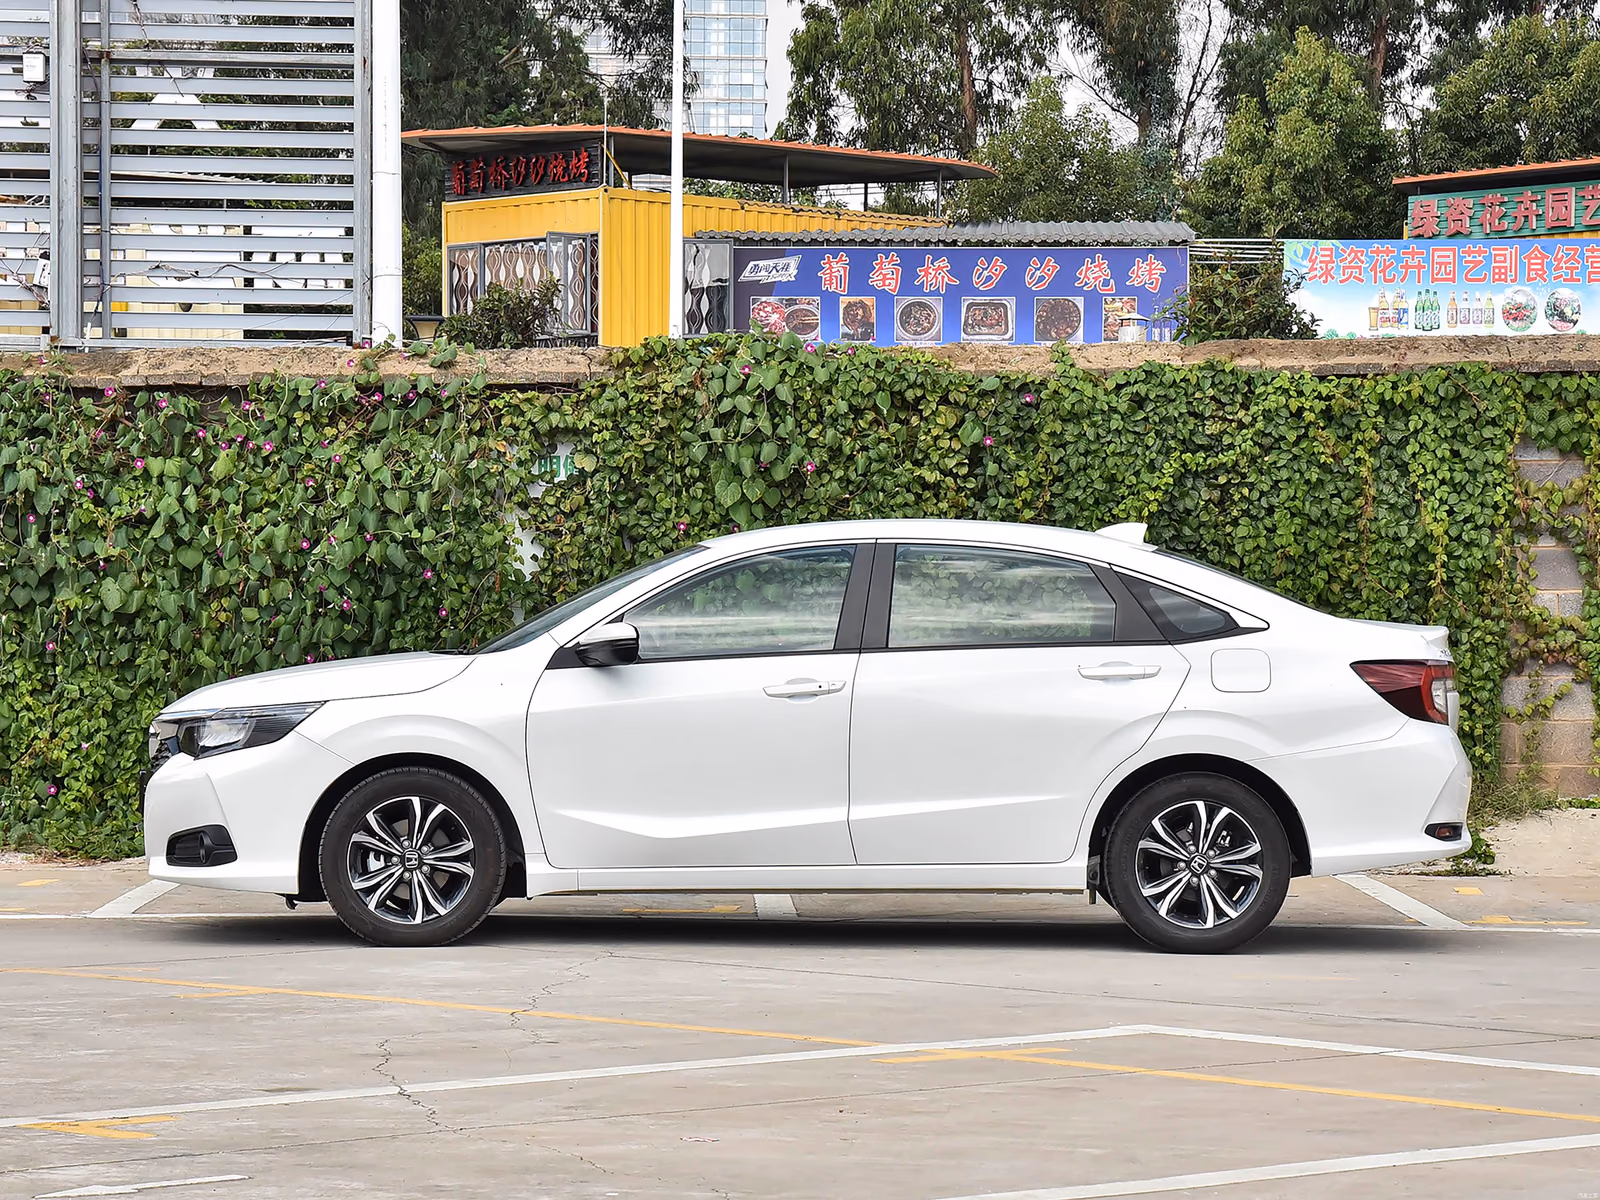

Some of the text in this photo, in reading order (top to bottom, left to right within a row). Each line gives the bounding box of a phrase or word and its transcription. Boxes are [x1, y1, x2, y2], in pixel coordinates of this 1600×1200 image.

[452, 147, 589, 195] 葡萄桥汐汐烧烤
[1410, 184, 1600, 238] 绿资花卉园艺
[819, 253, 1166, 294] 葡萄桥汐汐烧烤
